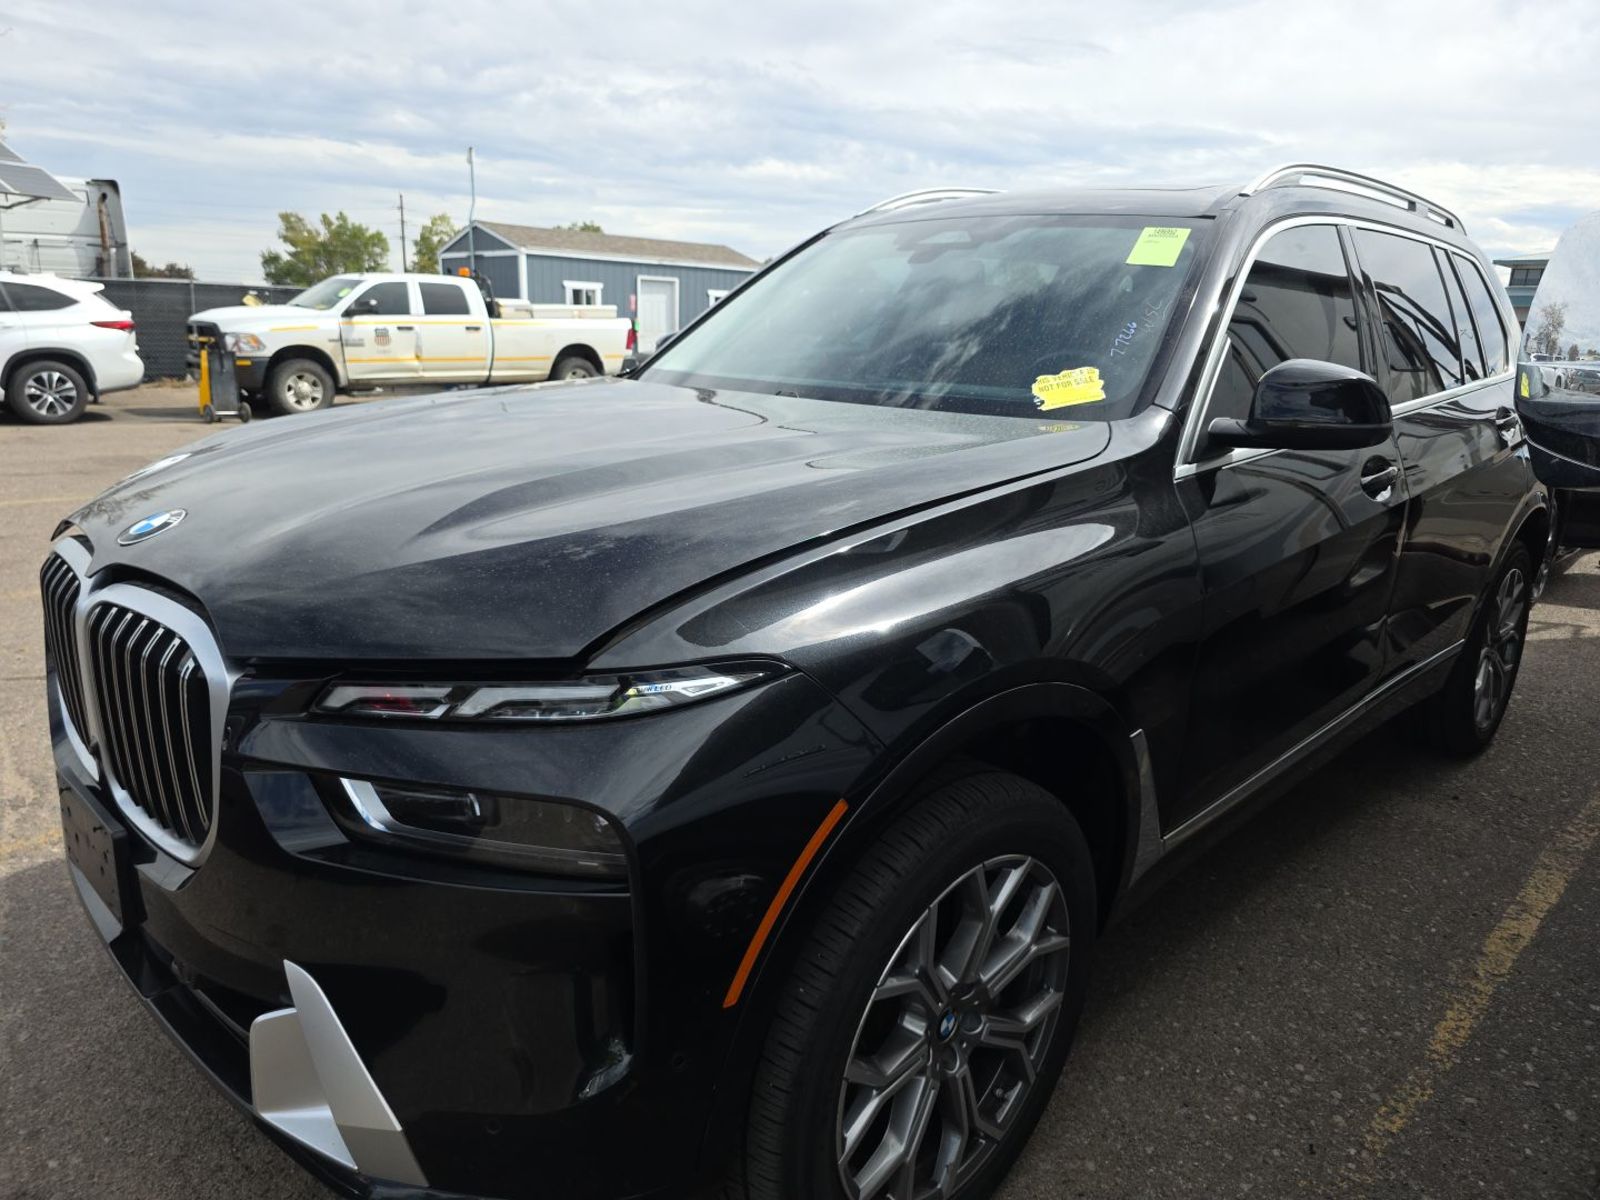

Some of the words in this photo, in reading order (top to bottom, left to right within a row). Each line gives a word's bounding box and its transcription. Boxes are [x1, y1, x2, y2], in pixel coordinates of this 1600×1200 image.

[1038, 383, 1054, 393] NOT
[1056, 380, 1073, 390] FOR
[1074, 375, 1096, 386] SALE
